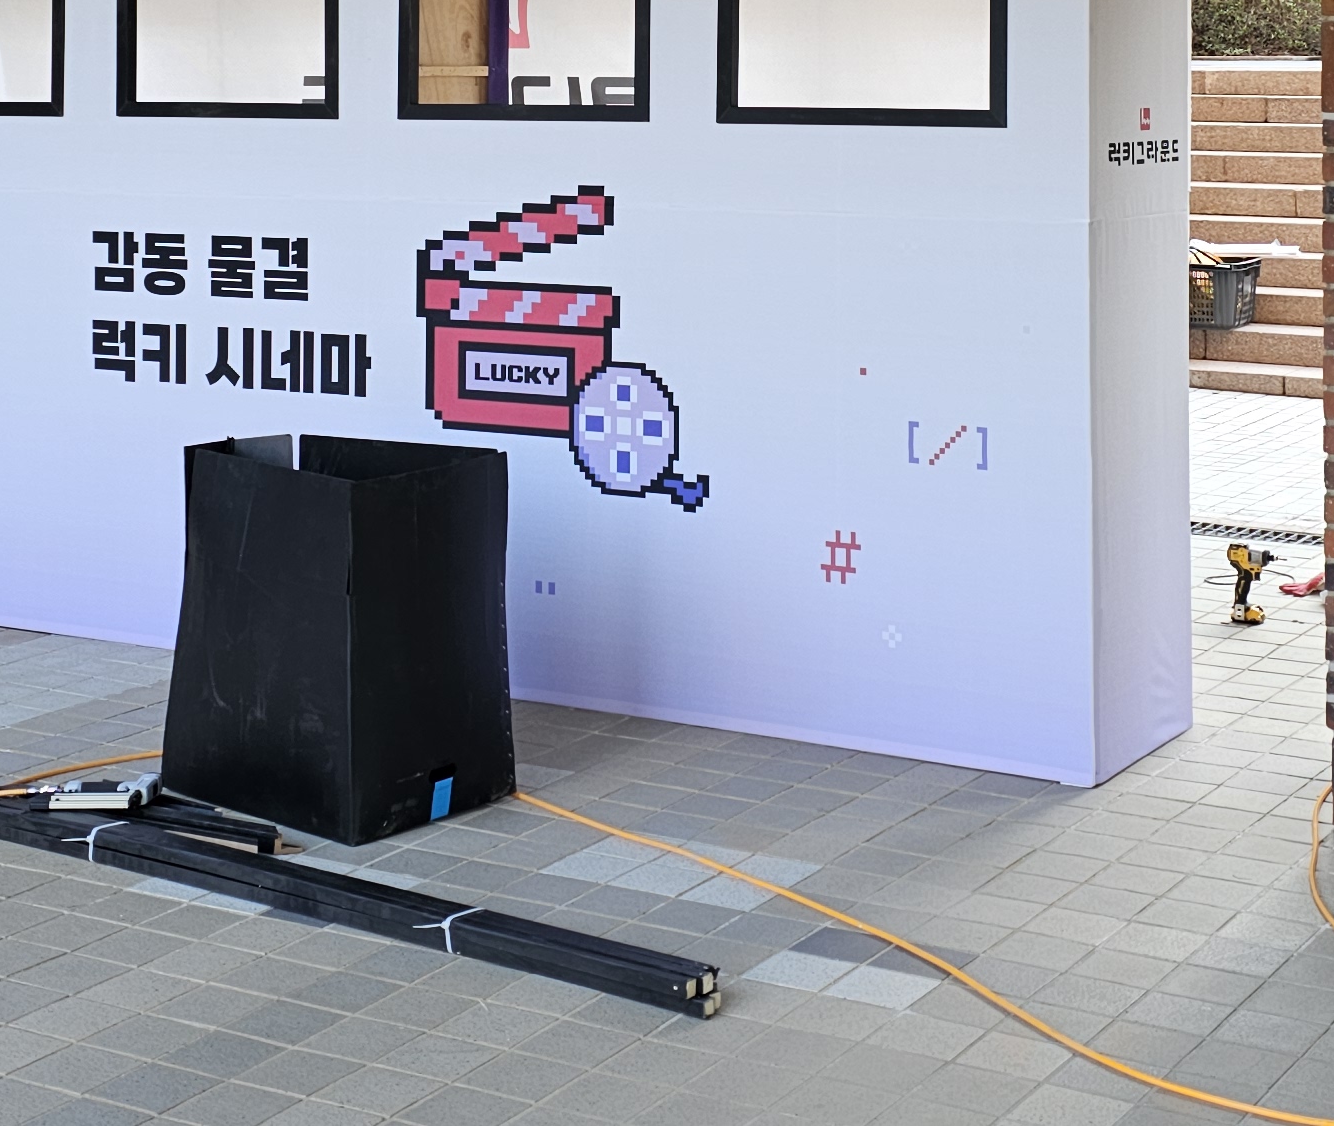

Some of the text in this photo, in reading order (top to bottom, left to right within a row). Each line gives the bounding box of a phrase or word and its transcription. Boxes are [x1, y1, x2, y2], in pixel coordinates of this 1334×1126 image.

[1108, 139, 1179, 166] 럭키그라운드
[92, 230, 310, 301] 감동 물결
[91, 319, 373, 398] 럭키 시네마
[474, 362, 561, 386] LUCKY
